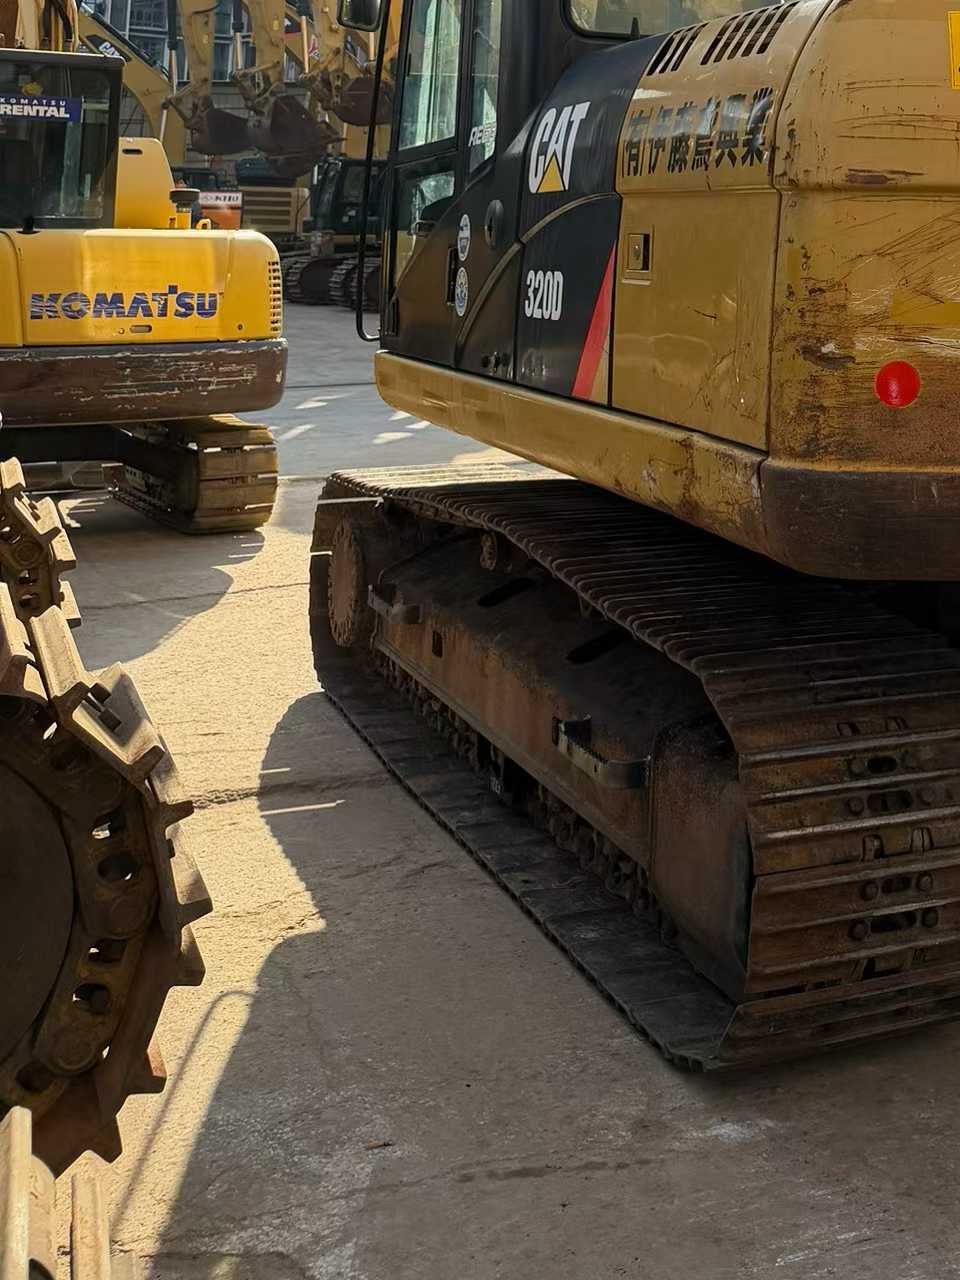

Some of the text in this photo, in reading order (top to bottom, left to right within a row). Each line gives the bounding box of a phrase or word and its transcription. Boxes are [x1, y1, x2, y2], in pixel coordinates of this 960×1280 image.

[0, 104, 70, 118] RENTAL
[528, 101, 591, 194] CAT
[30, 285, 218, 320] KOMATSU
[524, 270, 564, 321] 320D
